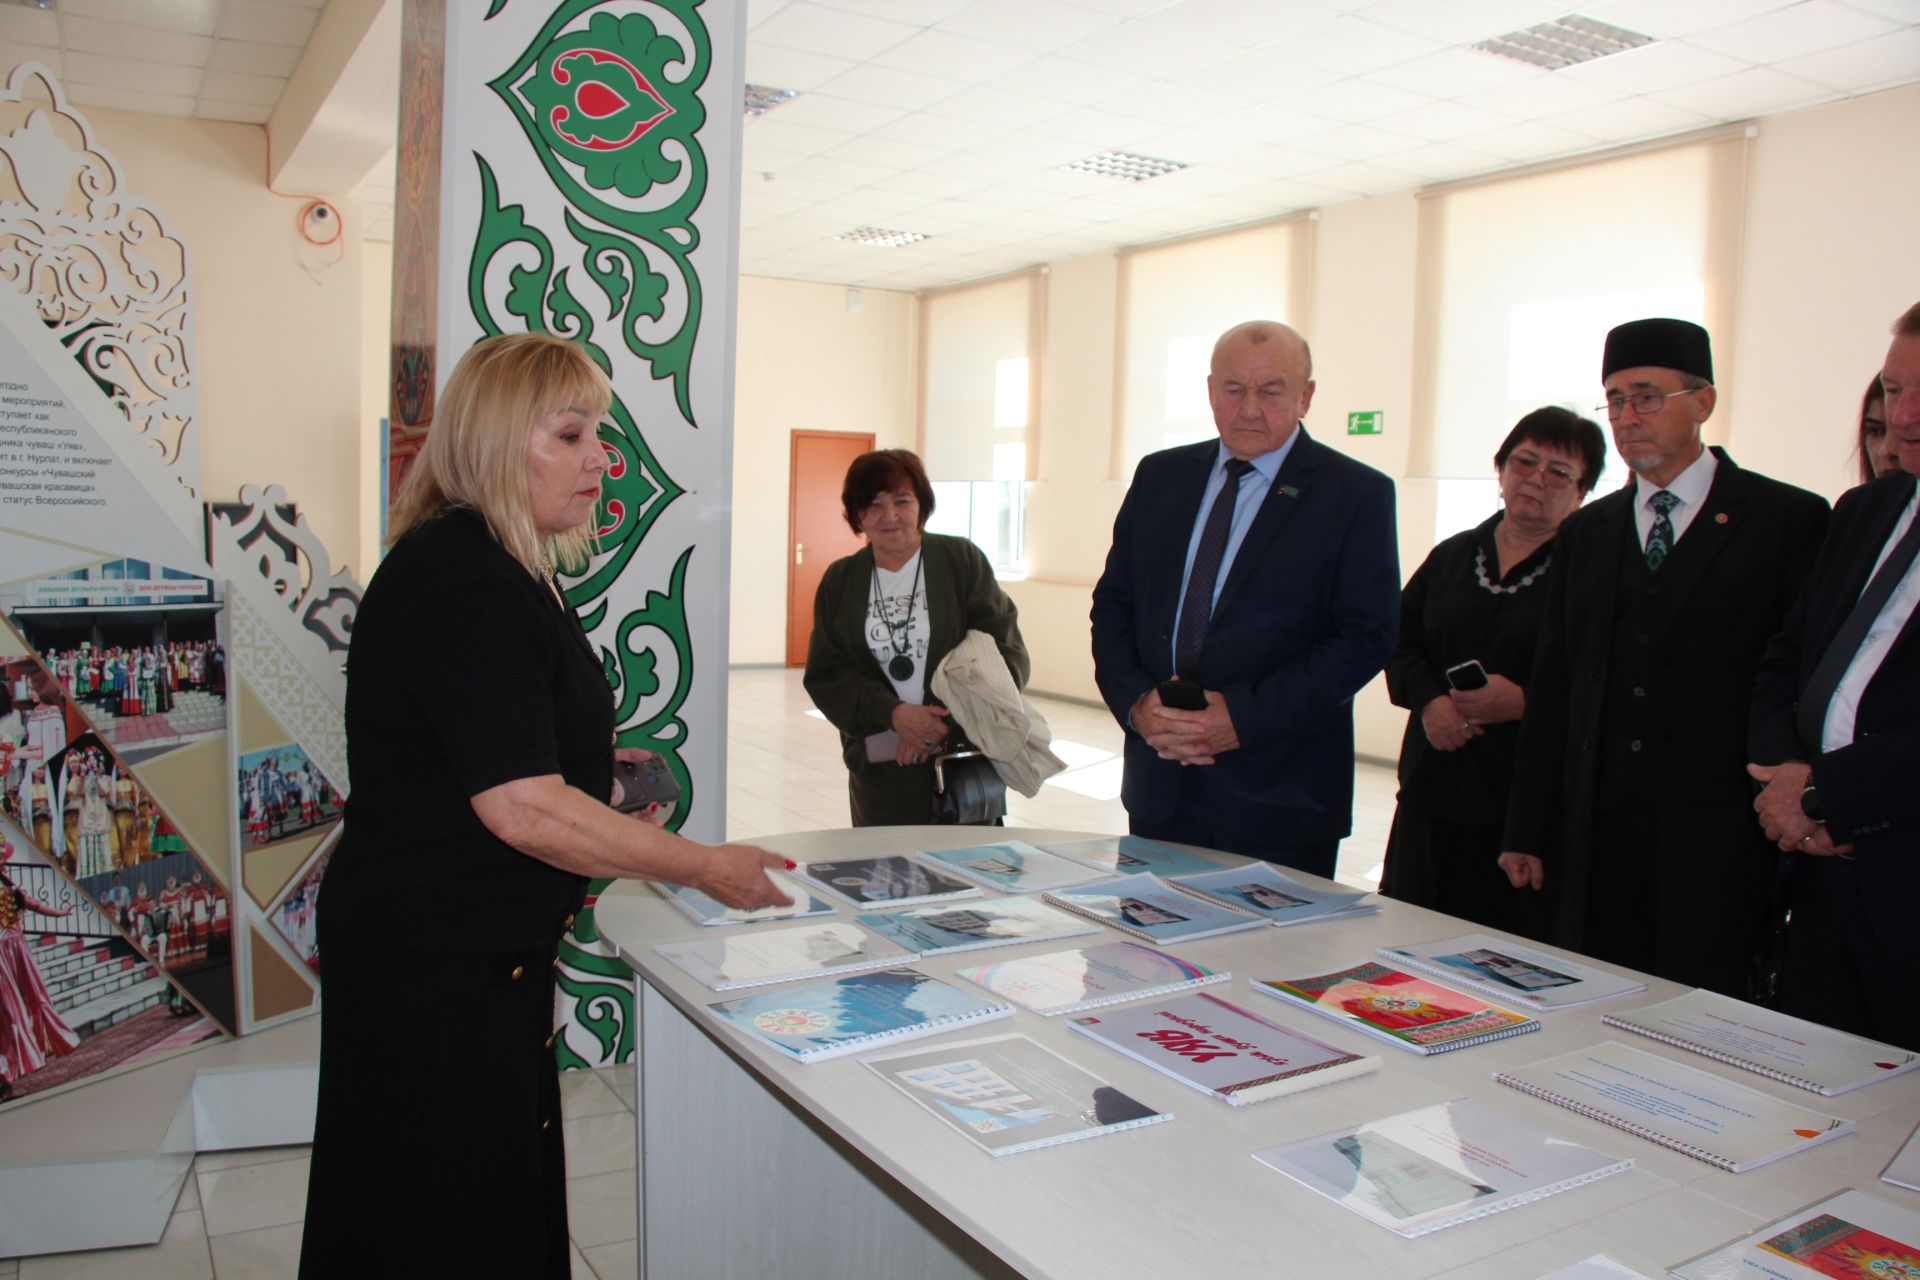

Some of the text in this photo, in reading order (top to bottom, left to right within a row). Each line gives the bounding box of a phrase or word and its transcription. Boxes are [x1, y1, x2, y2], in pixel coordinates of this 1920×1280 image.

[0, 382, 29, 391] годно
[0, 410, 49, 421] тупает как
[26, 440, 55, 449] чуваш
[72, 457, 112, 465] включает
[3, 496, 106, 506] статус Всероссийского
